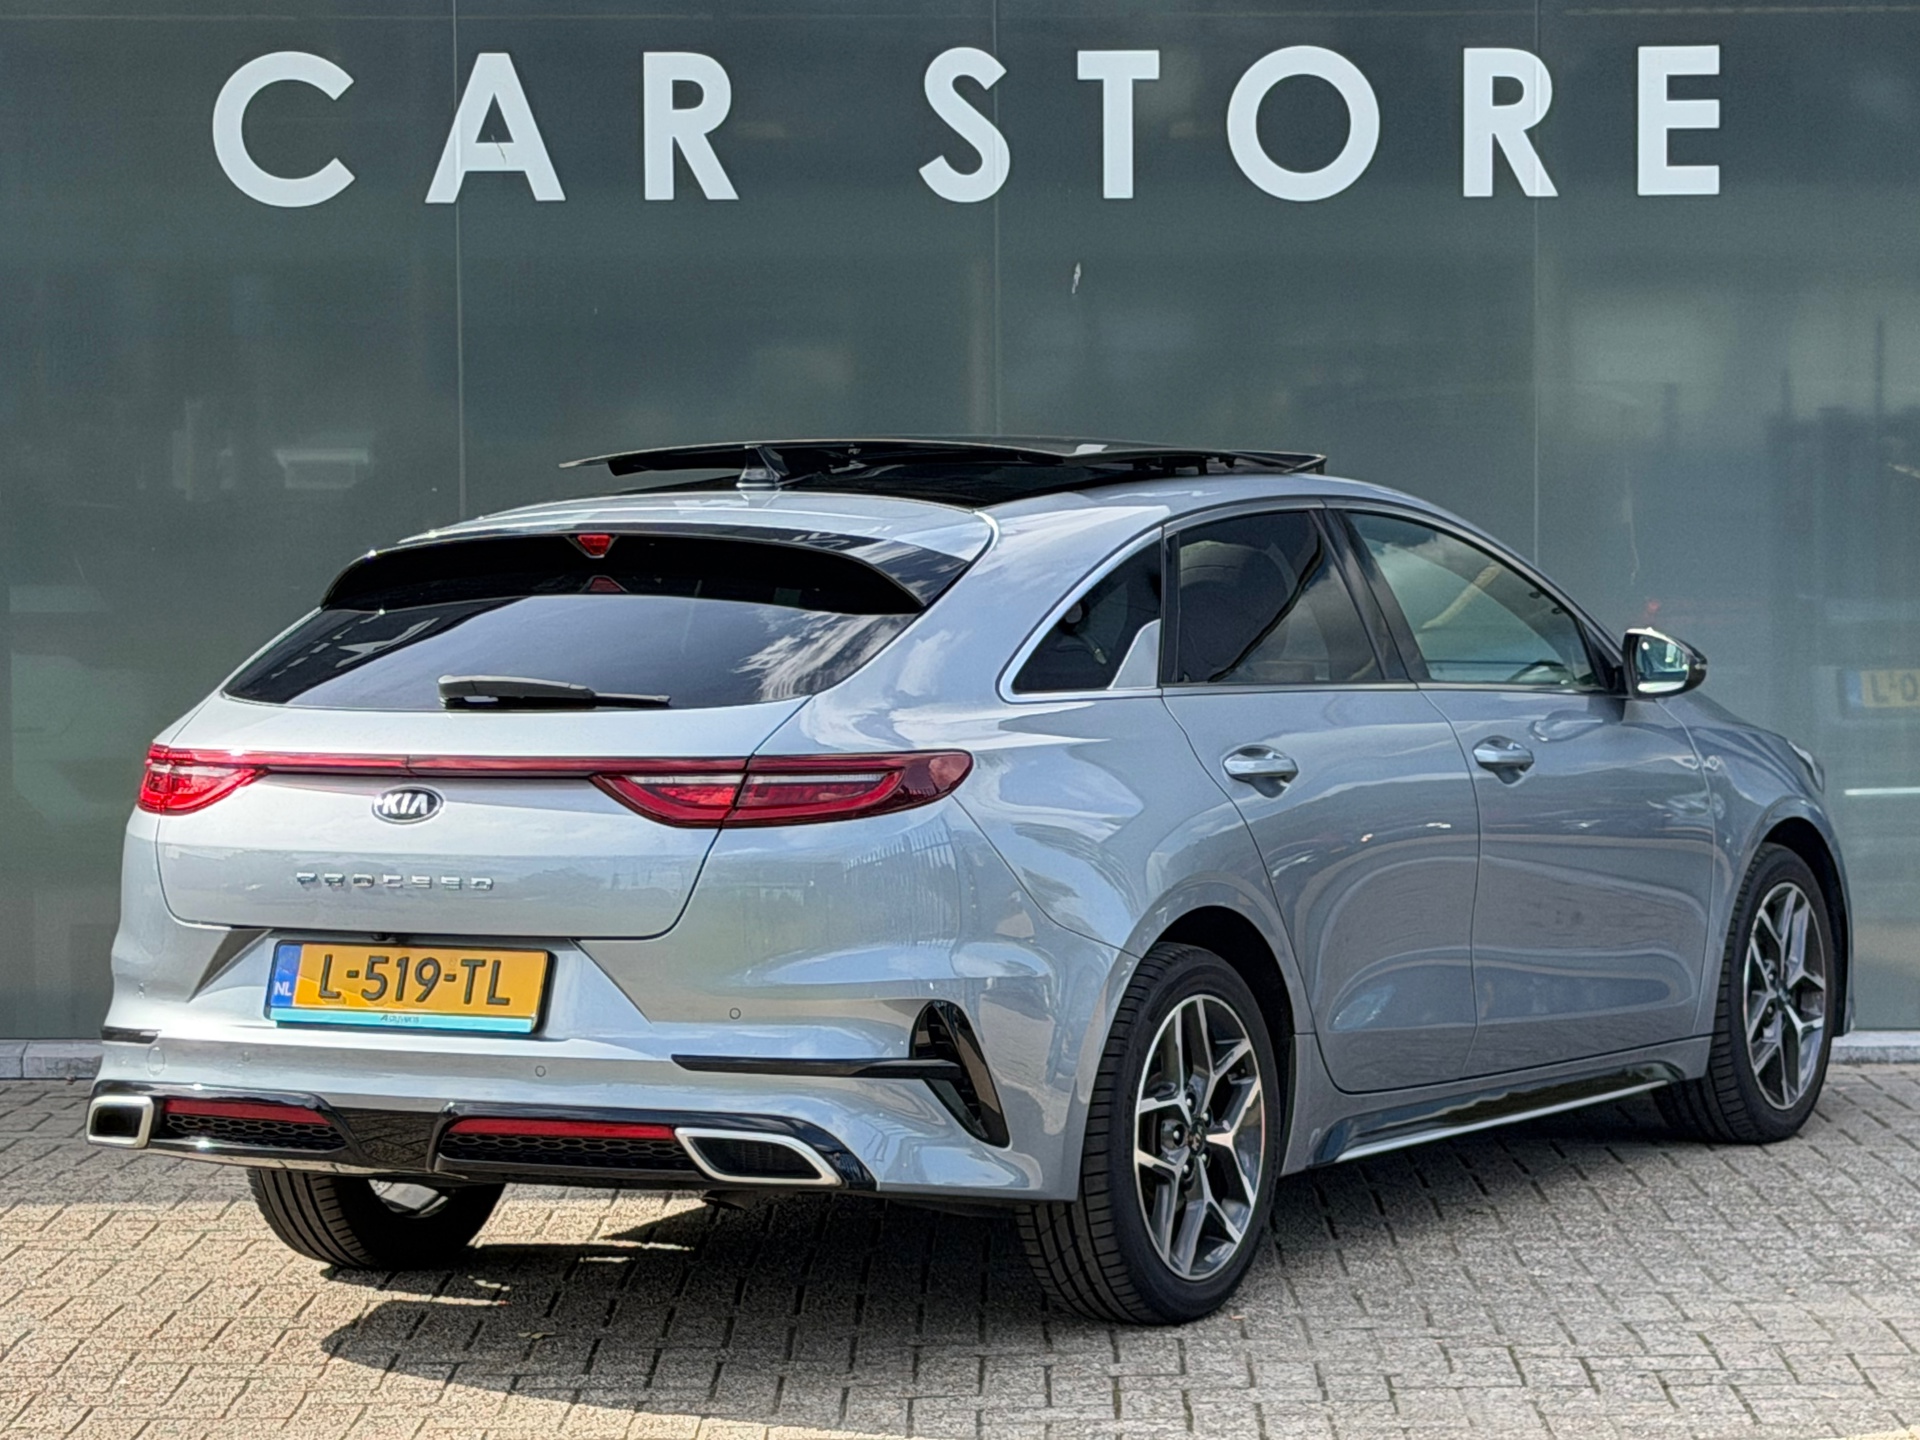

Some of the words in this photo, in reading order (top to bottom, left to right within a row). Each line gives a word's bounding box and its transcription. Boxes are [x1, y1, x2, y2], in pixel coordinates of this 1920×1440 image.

[212, 50, 739, 207] CAR
[918, 45, 1720, 203] STORE
[380, 792, 429, 815] KIA
[273, 980, 292, 996] NL
[317, 953, 511, 1006] L-519-TL
